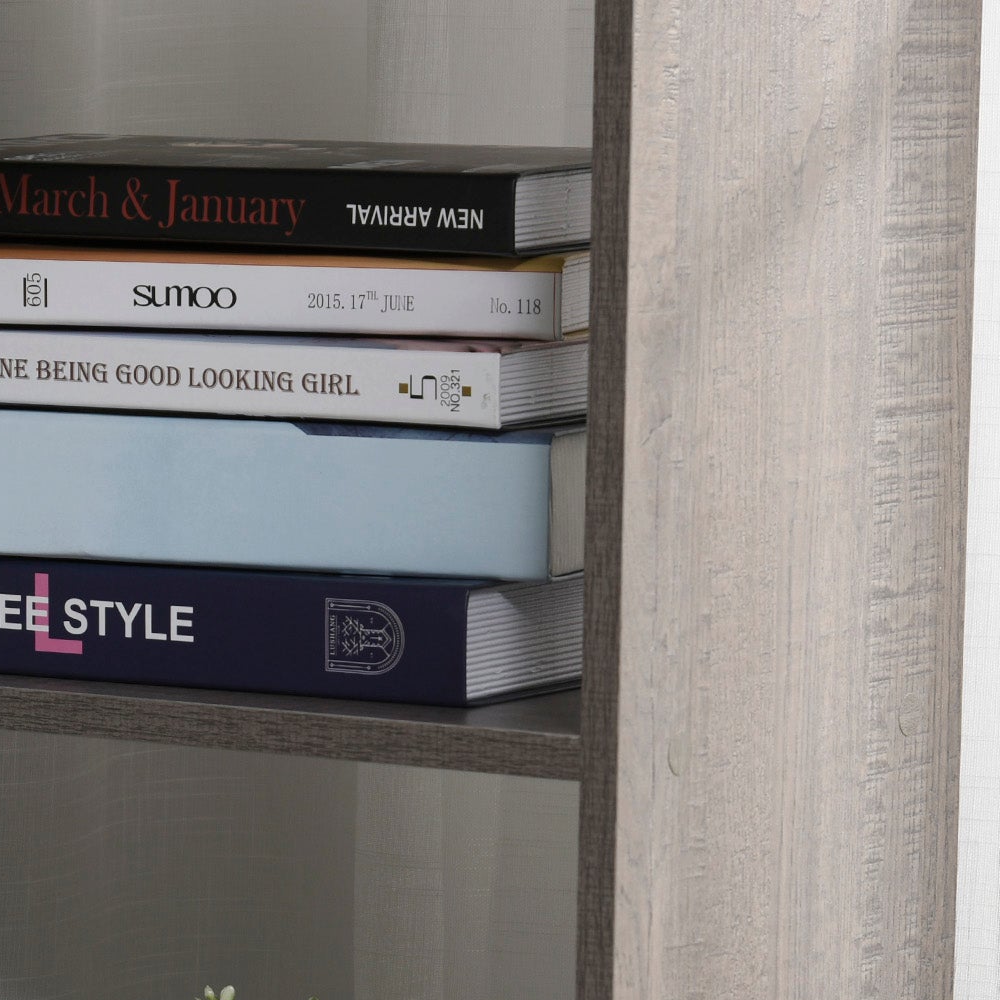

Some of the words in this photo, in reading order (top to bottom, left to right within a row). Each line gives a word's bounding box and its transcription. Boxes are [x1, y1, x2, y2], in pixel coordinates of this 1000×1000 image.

[121, 177, 152, 221] &
[159, 179, 306, 236] January
[346, 203, 432, 227] ARRIVAL
[437, 208, 484, 229] NEW
[26, 272, 42, 307] 605
[132, 284, 237, 309] sumoo
[307, 292, 345, 310] 2015.
[381, 294, 415, 312] JUNE
[490, 297, 511, 314] No.
[517, 299, 541, 315] 118
[36, 360, 109, 383] BEING
[115, 364, 181, 386] GOOD
[188, 367, 294, 393] LOOKING
[301, 372, 360, 396] GIRL
[63, 598, 194, 642] STYLE
